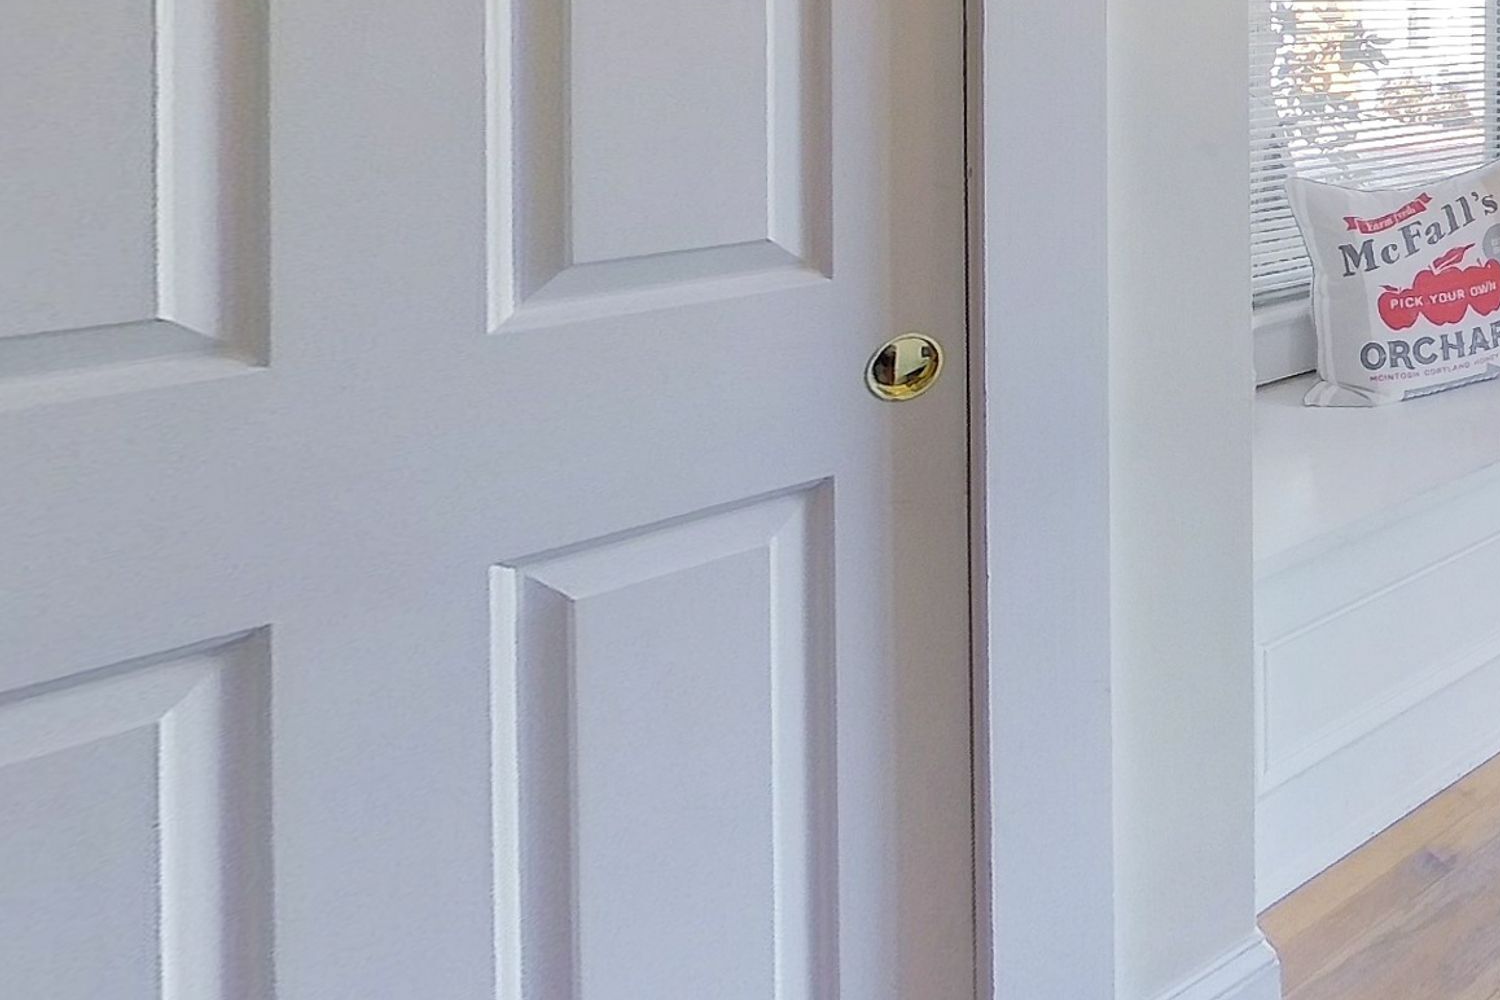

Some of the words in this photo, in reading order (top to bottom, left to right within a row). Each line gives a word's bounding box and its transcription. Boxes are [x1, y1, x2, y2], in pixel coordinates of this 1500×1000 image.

[1338, 191, 1499, 278] McFall's
[1390, 296, 1424, 310] PICK
[1429, 289, 1465, 304] YOUR
[1470, 281, 1497, 297] OWN
